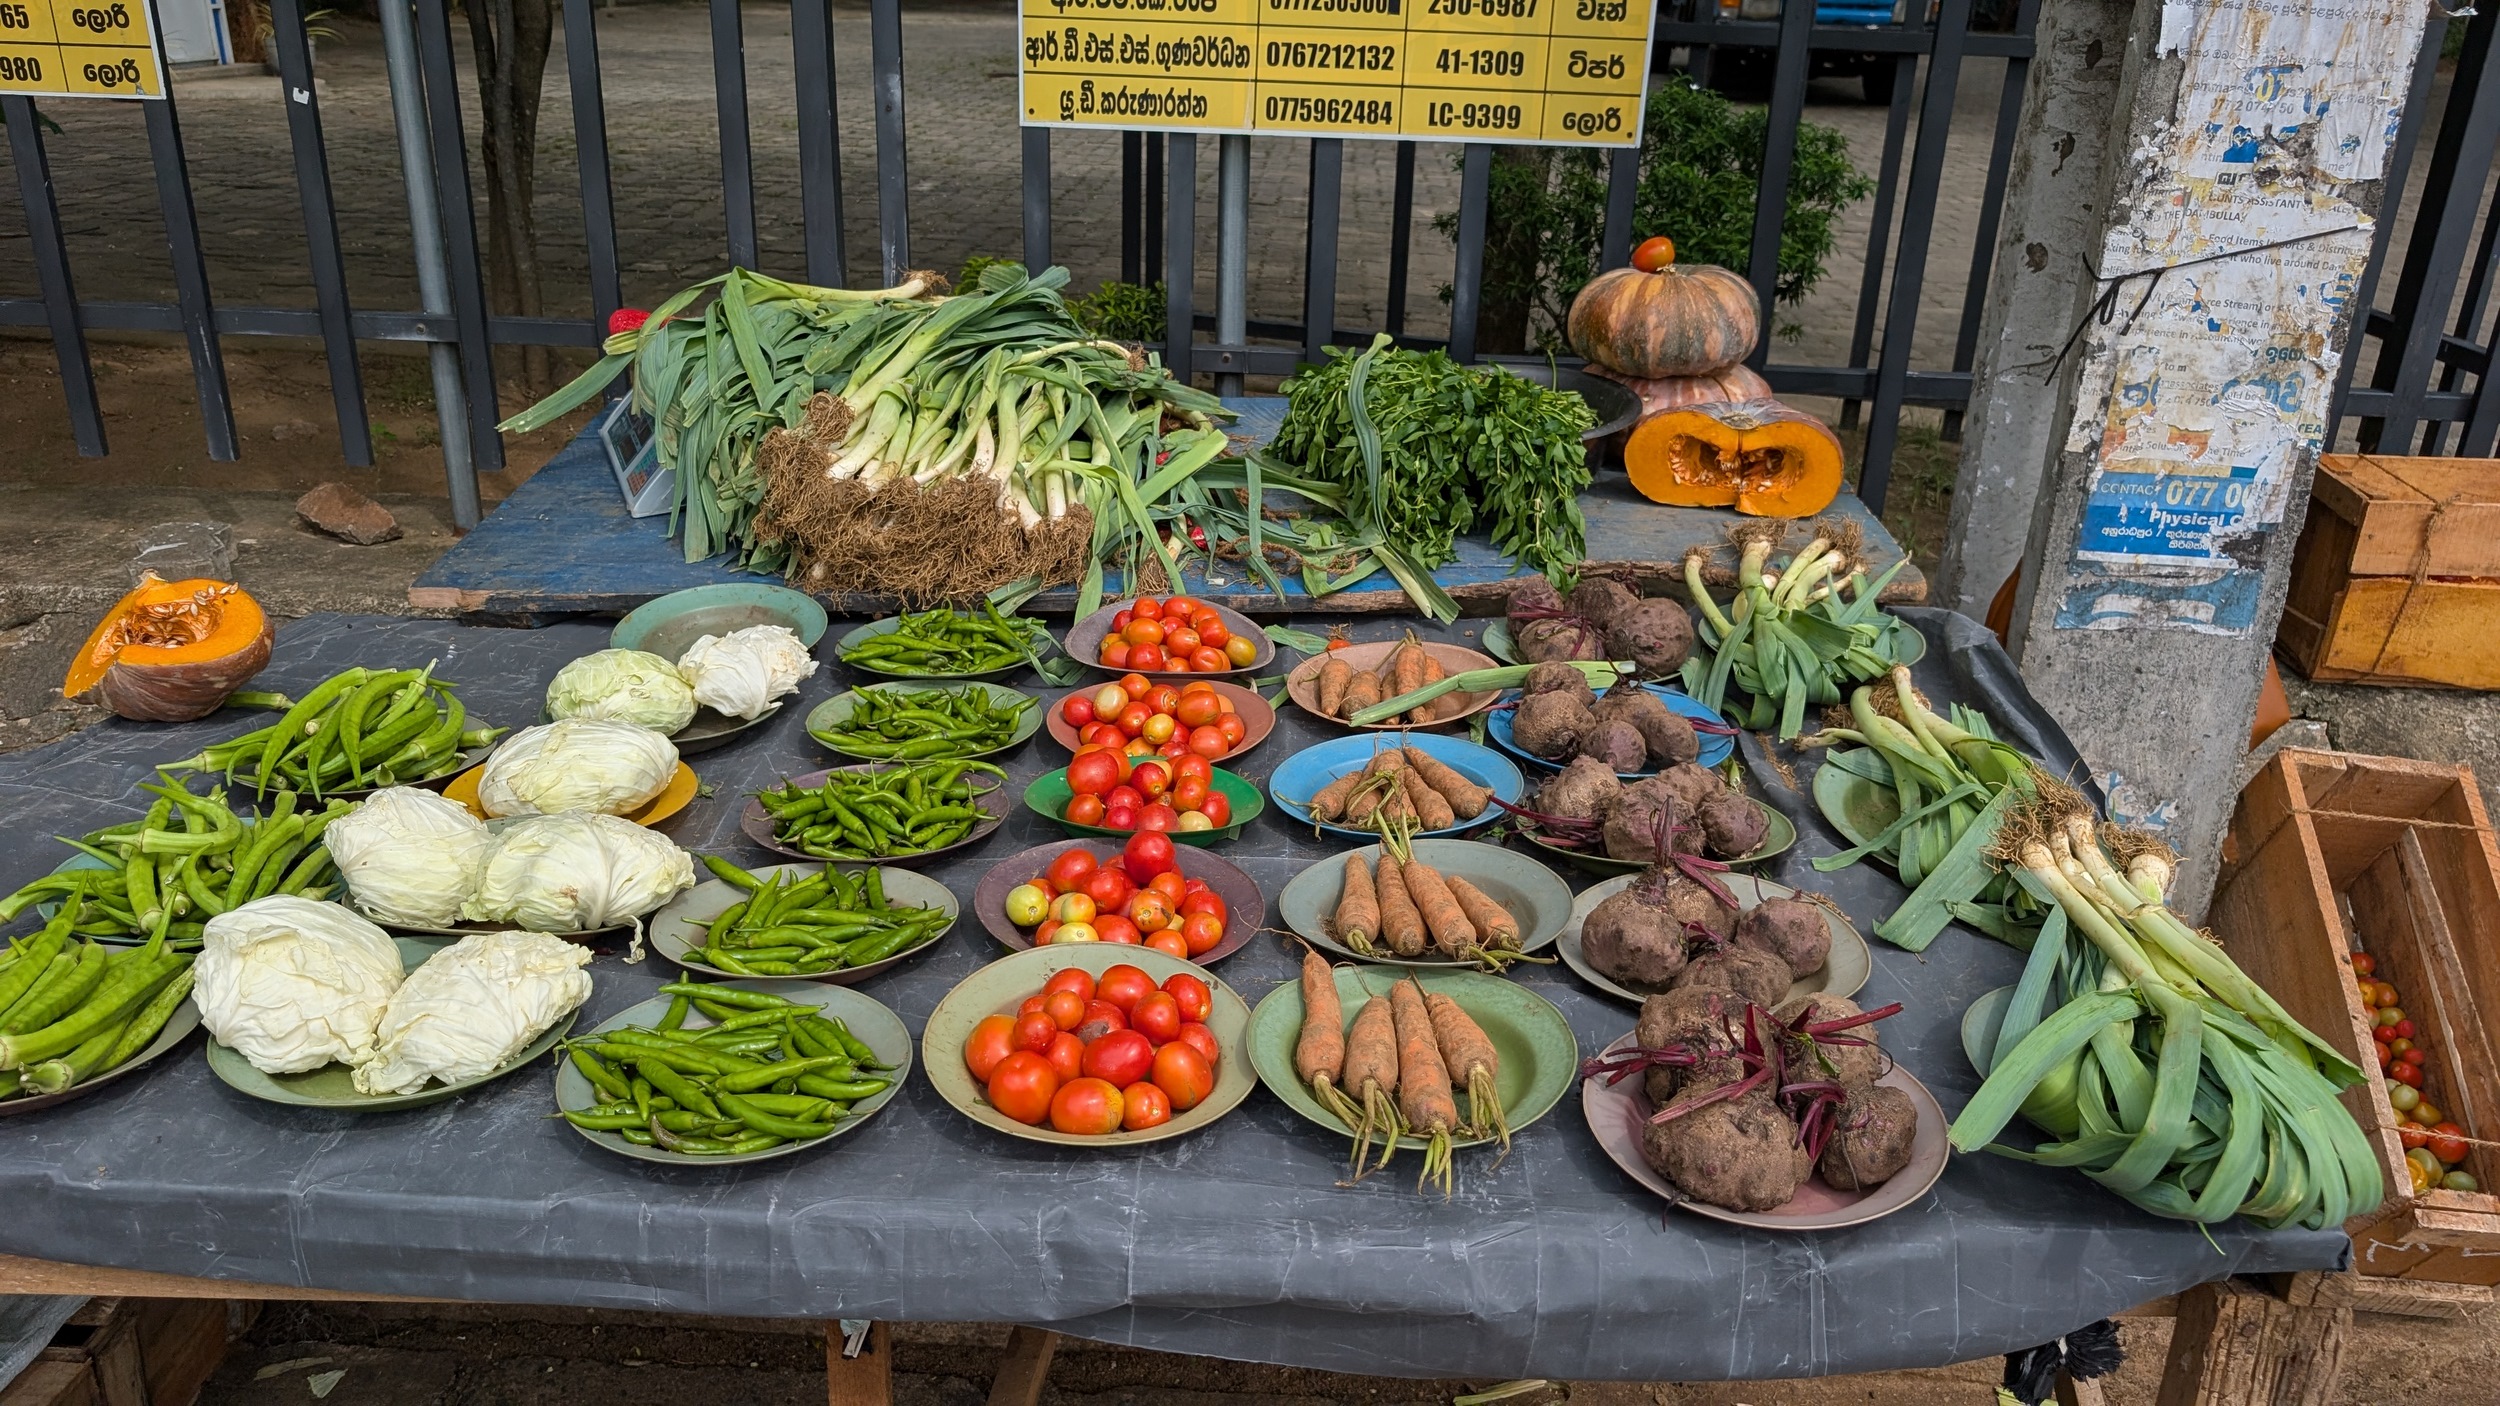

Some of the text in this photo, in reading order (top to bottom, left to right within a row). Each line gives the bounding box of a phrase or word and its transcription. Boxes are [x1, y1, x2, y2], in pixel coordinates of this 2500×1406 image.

[72, 3, 130, 34] ලොරි
[1266, 41, 1396, 71] 0767212132
[1436, 49, 1524, 77] 41-1309
[1567, 50, 1625, 80] ටිපර්
[83, 58, 141, 88] ලොරි
[1266, 96, 1393, 125] 0775962484
[1428, 102, 1521, 130] LC-9399
[1563, 107, 1621, 137] ලොරි
[2235, 235, 2263, 248] Items
[2284, 257, 2319, 269] around
[2165, 480, 2219, 507] 077
[2150, 509, 2225, 526] Physical
